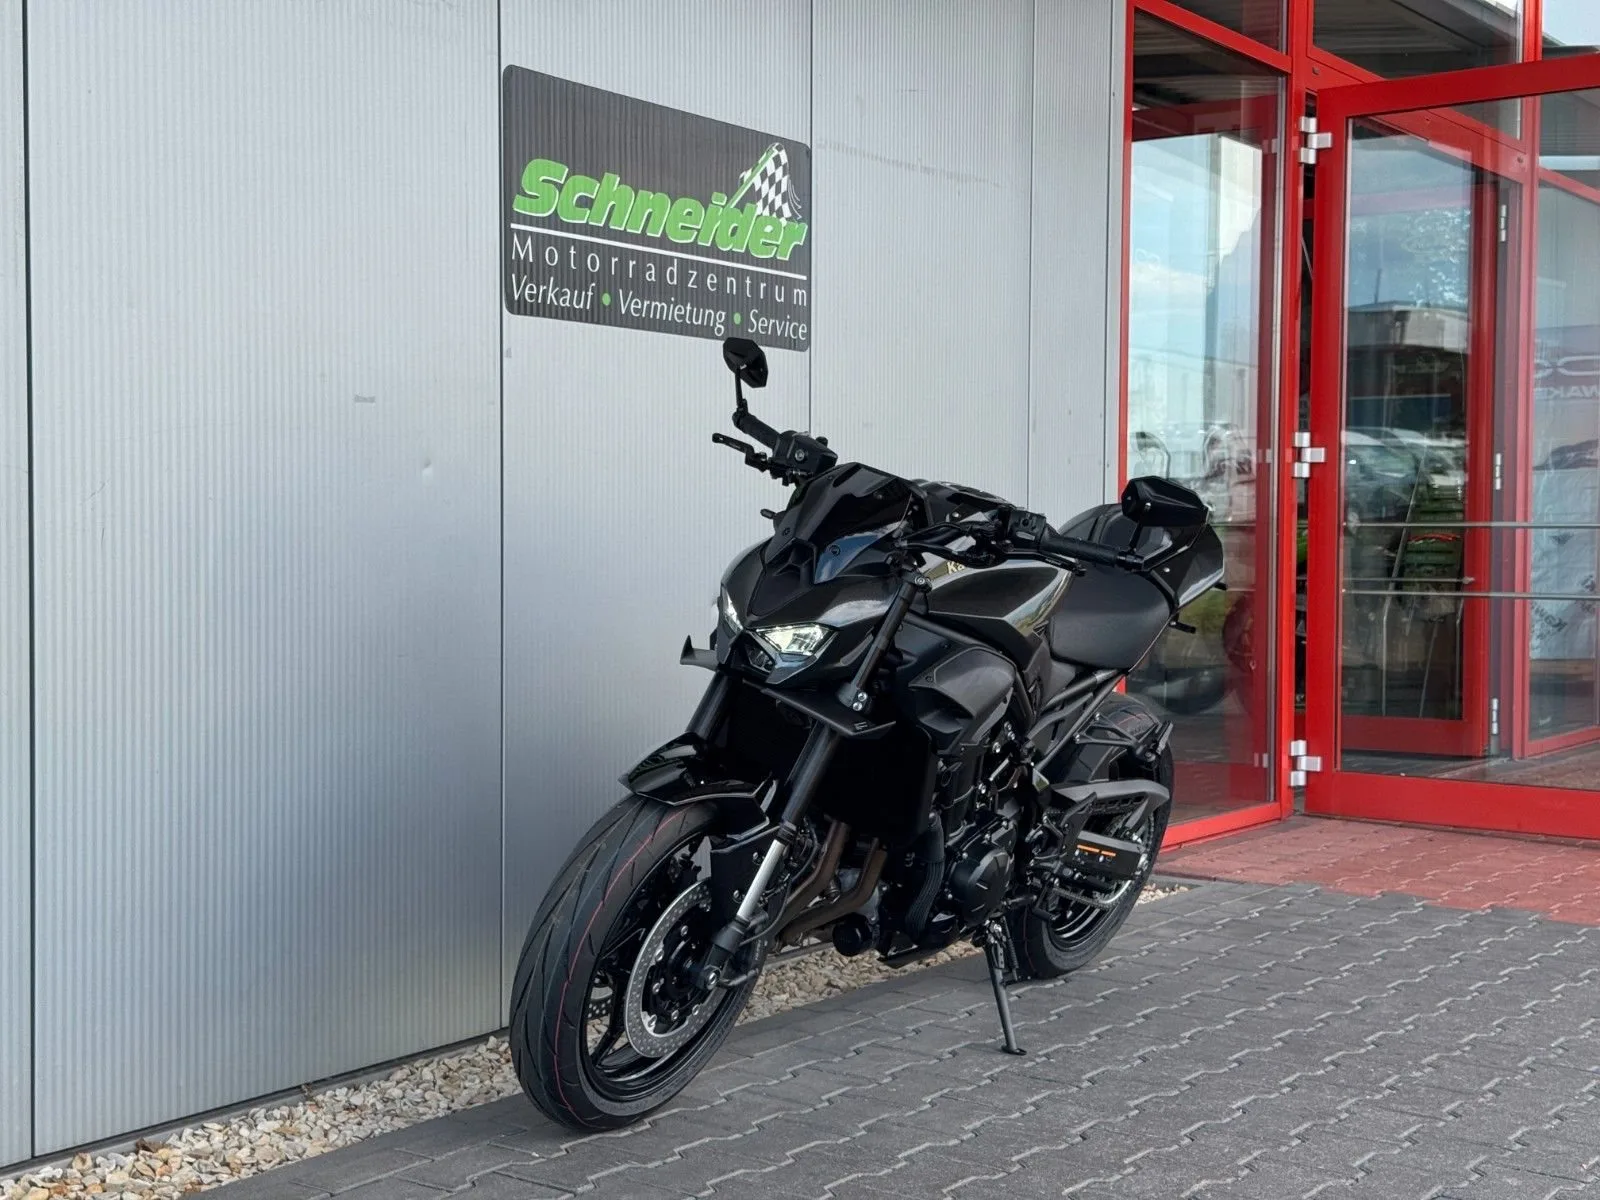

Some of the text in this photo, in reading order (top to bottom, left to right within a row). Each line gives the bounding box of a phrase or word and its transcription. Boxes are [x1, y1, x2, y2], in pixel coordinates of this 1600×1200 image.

[512, 158, 808, 260] Schneider
[511, 232, 807, 306] Motorradzentrum
[511, 273, 808, 341] Verkauf Vermietung Service
